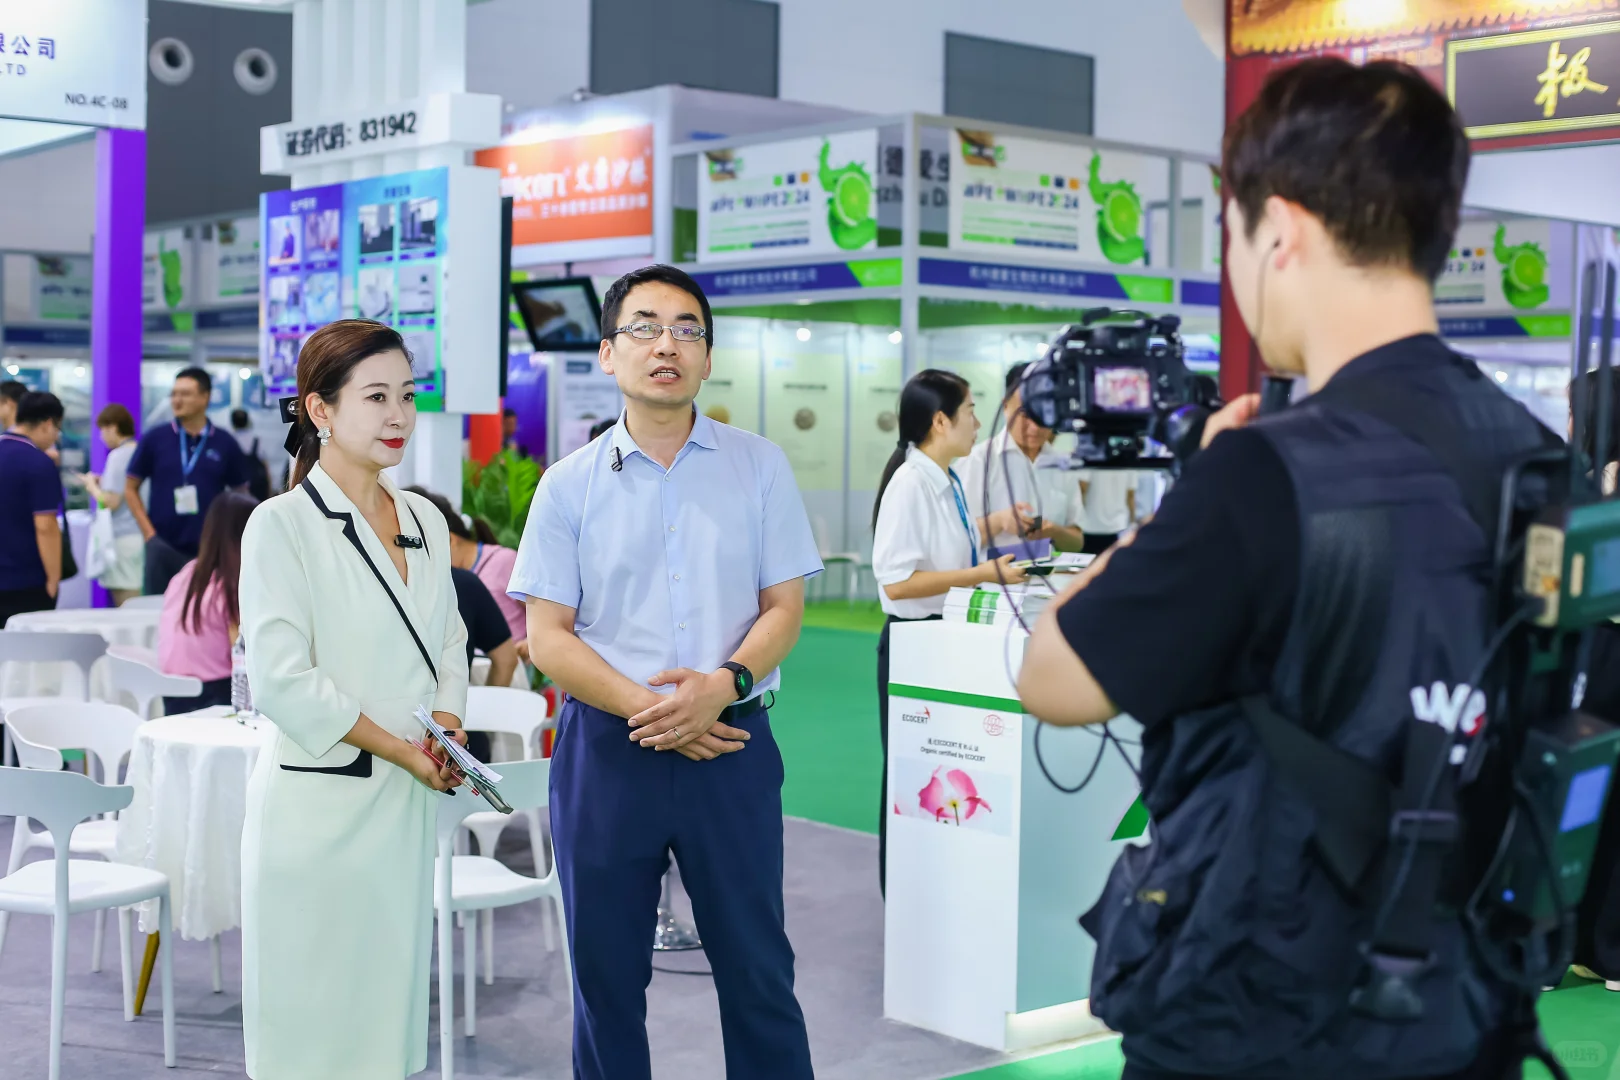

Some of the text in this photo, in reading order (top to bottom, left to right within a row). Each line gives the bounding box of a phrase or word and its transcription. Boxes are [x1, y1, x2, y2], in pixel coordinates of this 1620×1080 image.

[0, 62, 26, 75] TD
[359, 111, 417, 142] 831942
[902, 714, 928, 725] ECOCERT
[920, 746, 938, 755] Organic
[938, 749, 957, 758] certified
[965, 754, 986, 762] ECOCERT
